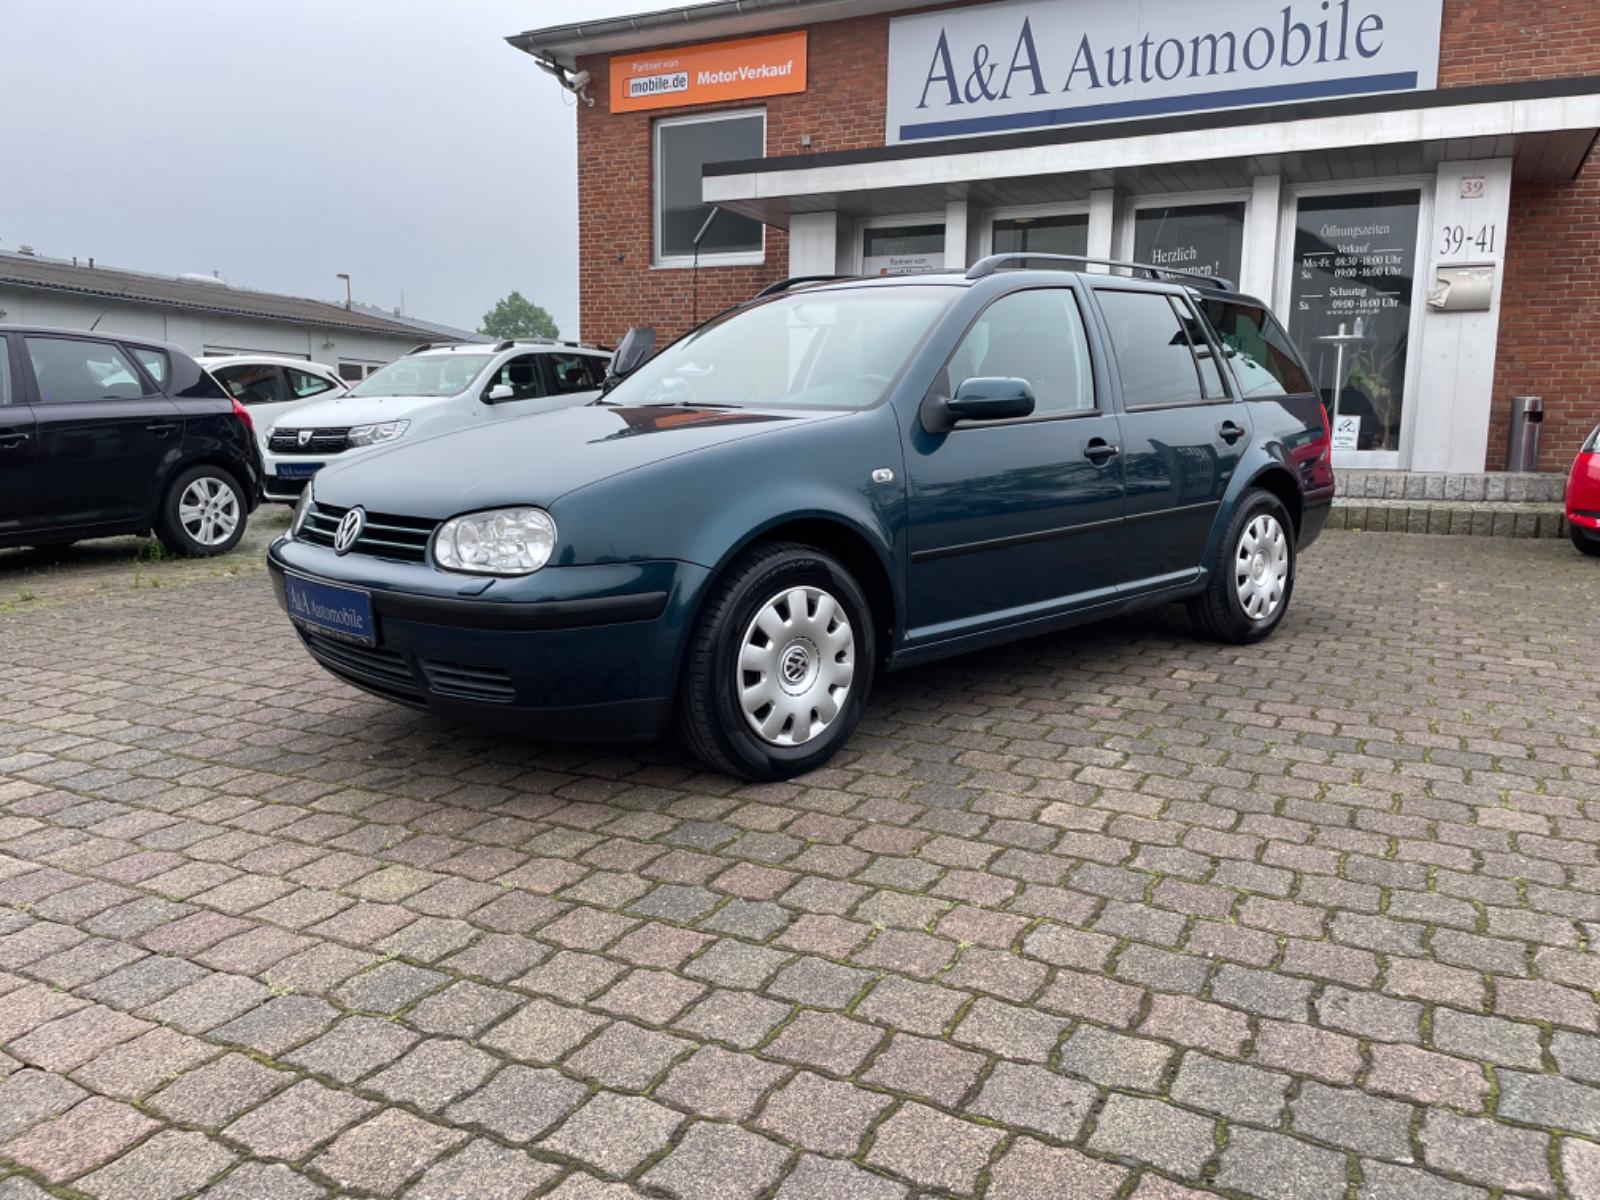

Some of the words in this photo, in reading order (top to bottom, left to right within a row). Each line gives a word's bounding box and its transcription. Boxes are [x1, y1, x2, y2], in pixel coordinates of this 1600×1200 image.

[916, 16, 1051, 110] A&A
[1061, 0, 1385, 93] Automobile
[632, 60, 662, 72] Partner
[663, 59, 679, 68] von
[631, 74, 687, 94] mobile.de
[1463, 181, 1484, 194] 39
[1320, 223, 1390, 239] Öffnungszeiten
[1439, 224, 1496, 255] 39-41
[1152, 241, 1198, 264] Herzlich
[1337, 242, 1370, 254] Verkauf
[1385, 254, 1402, 265] Uhr
[1385, 265, 1402, 276] Uhr
[1329, 286, 1368, 298] Schautag
[1382, 297, 1400, 307] Uhr
